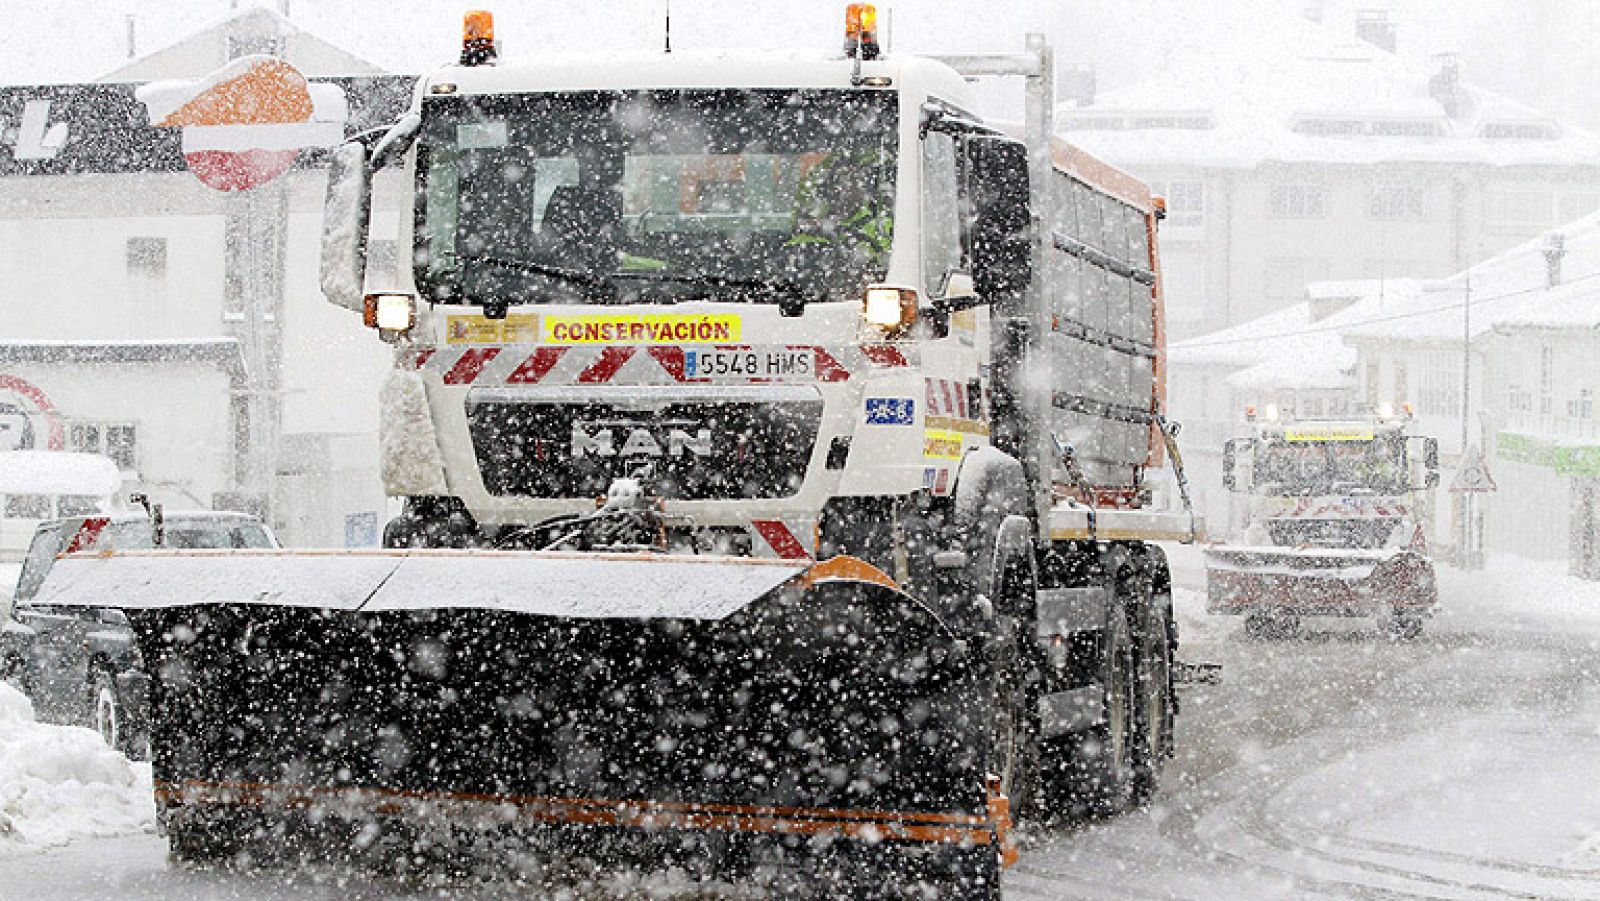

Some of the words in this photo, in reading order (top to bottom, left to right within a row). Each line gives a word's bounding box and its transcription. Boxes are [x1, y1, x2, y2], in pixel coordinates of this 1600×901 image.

[553, 316, 730, 341] CONSERVACIÓN
[701, 354, 757, 374] 5548
[766, 354, 809, 374] HMS
[571, 427, 711, 456] MAN
